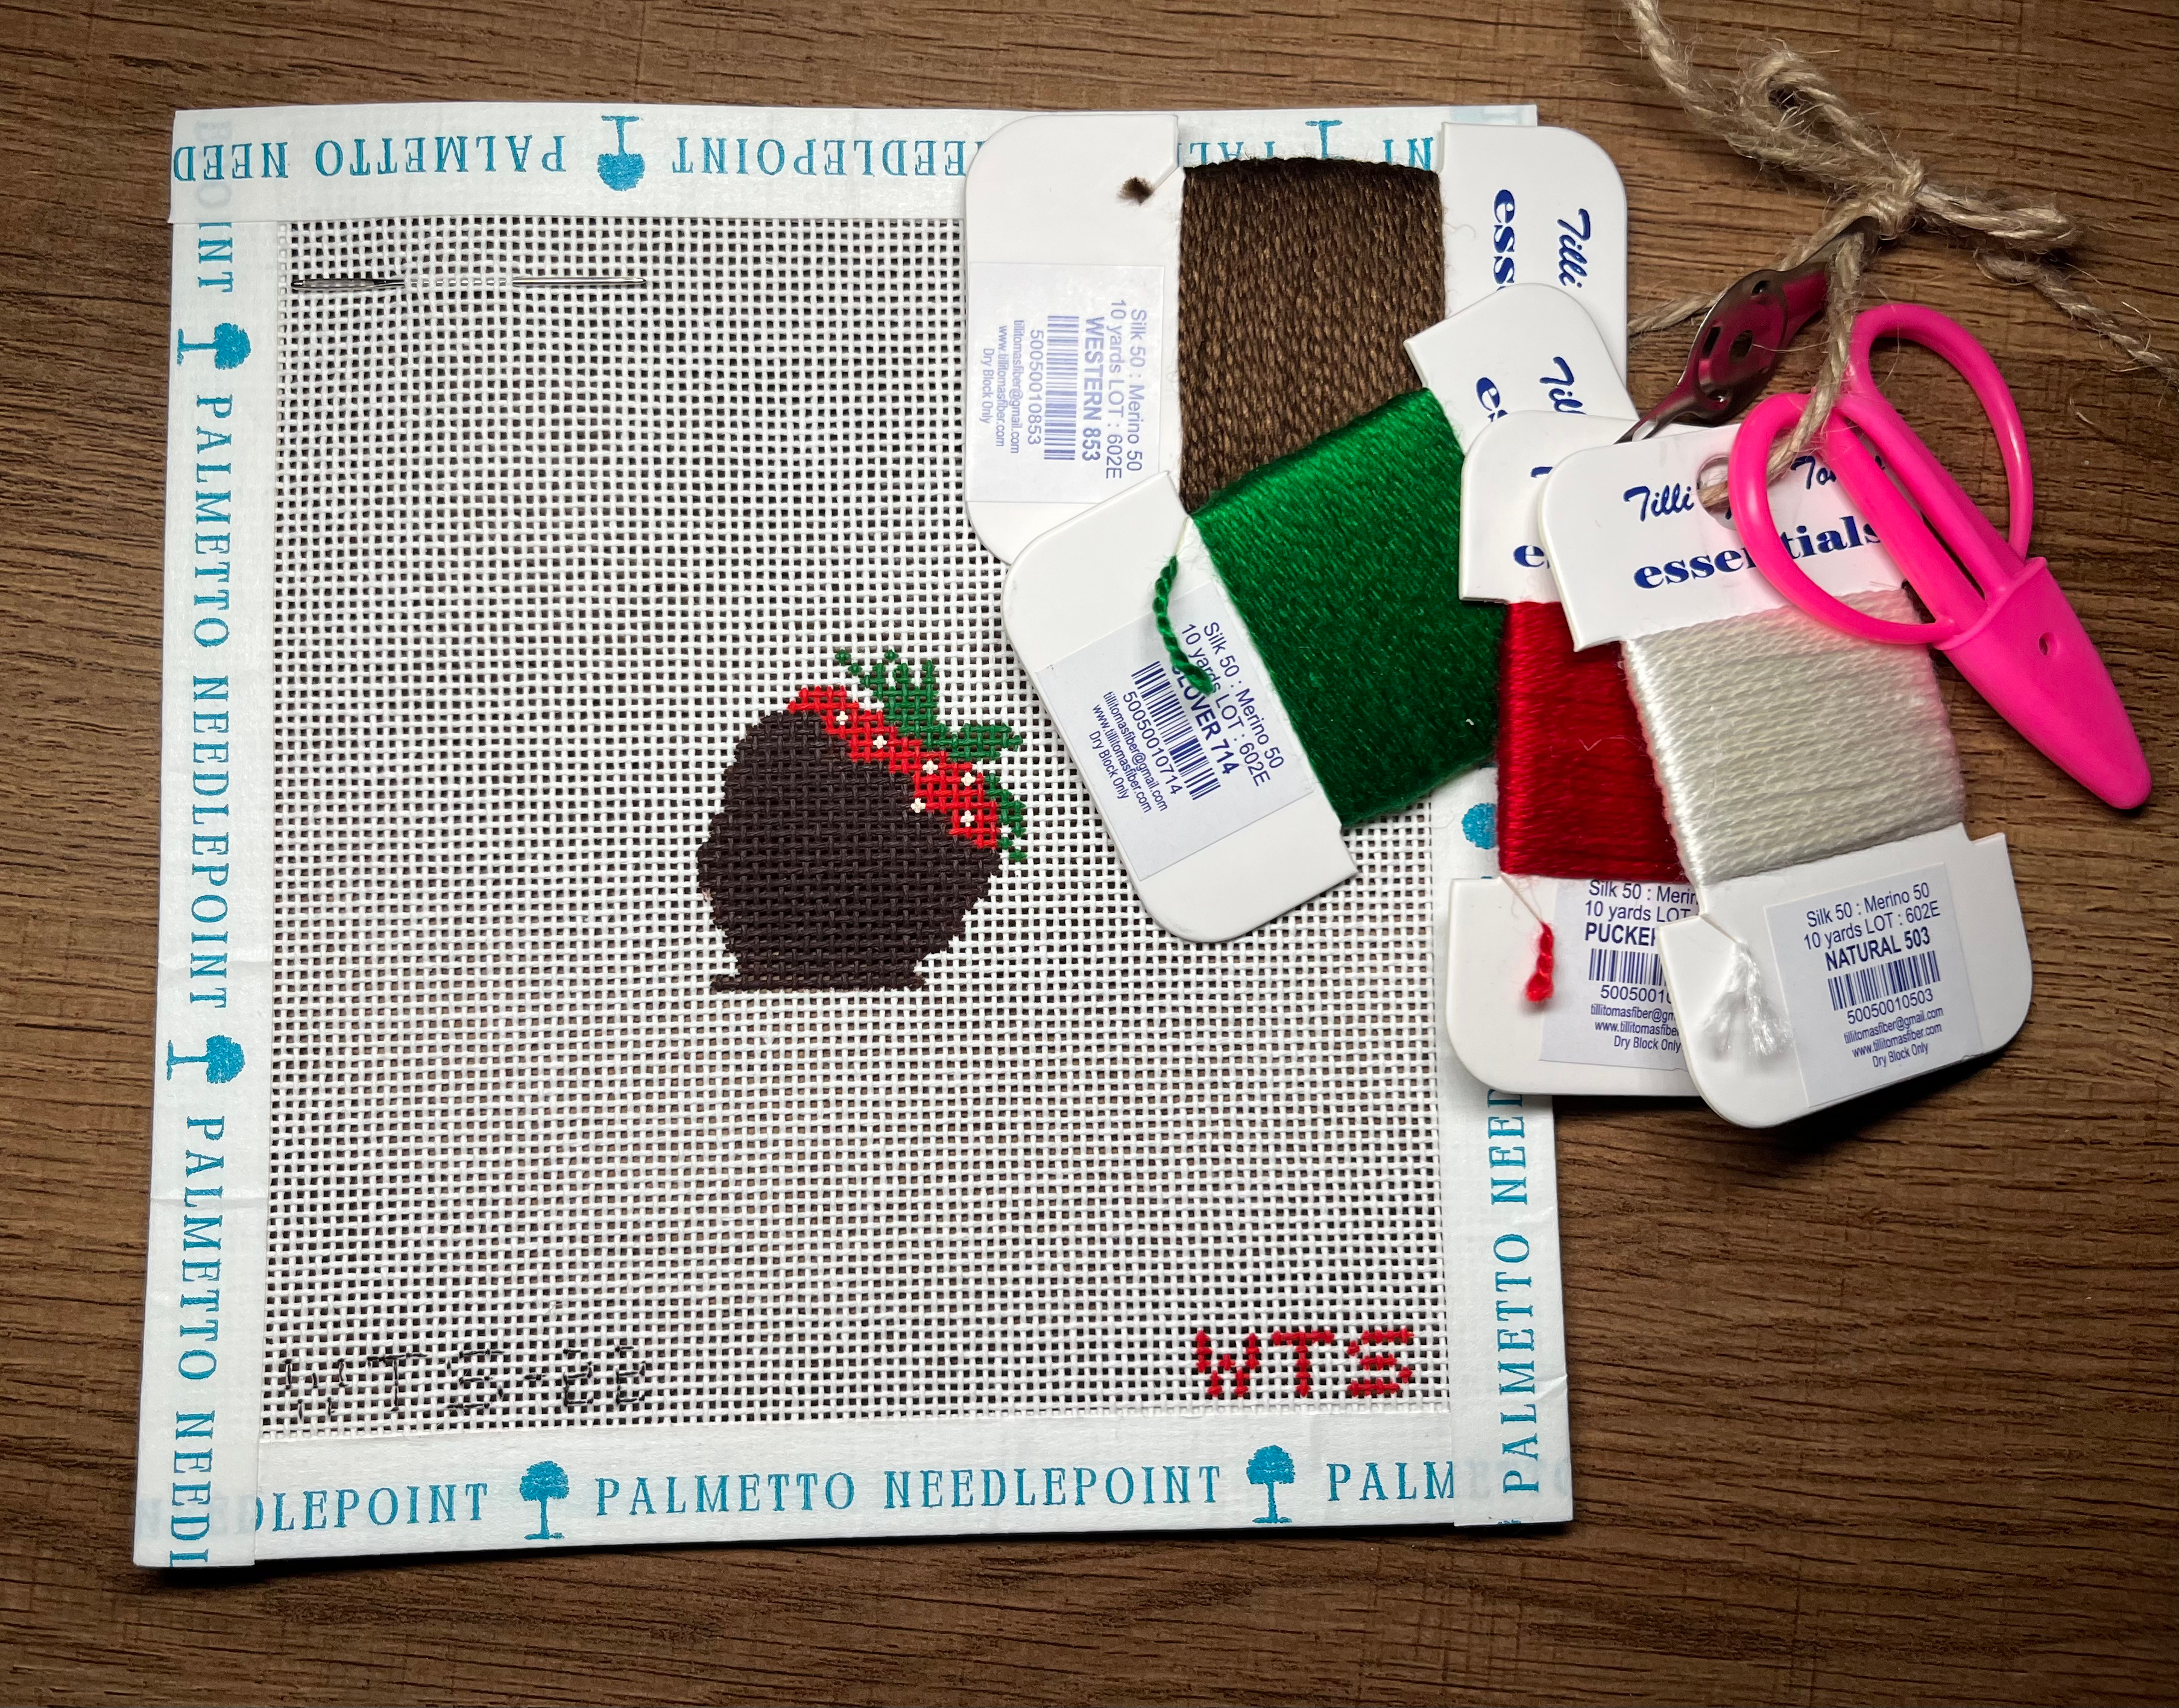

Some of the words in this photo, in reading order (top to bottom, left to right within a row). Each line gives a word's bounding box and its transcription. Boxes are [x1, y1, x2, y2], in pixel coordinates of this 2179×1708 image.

[173, 142, 289, 182] NEED
[314, 134, 567, 177] PALMETTO
[672, 136, 984, 177] EEDLEPOINT
[1493, 189, 1515, 292] ess
[1557, 208, 1591, 288] Tilli
[1111, 300, 1126, 320] 10
[1131, 309, 1146, 340] Silk
[980, 348, 995, 368] Dry
[1083, 317, 1105, 420] WESTERN
[1106, 326, 1125, 374] yards
[1130, 346, 1146, 367] 50
[982, 369, 995, 400] Block
[995, 326, 1008, 447] www.tillitomasfiber.com
[1009, 320, 1025, 453] tillitomasfiber@gmail.com
[1027, 330, 1044, 446] 50050010853
[1108, 380, 1124, 417] LOT
[1539, 356, 1587, 415] Til
[979, 401, 994, 424] Only
[1127, 385, 1145, 444] Merino
[1082, 427, 1102, 462] 853
[1106, 435, 1123, 479] 602E
[1126, 450, 1143, 471] 50
[193, 394, 233, 649] PALMETTO
[1623, 483, 1695, 522] Tilli
[1182, 623, 1201, 645] 10
[1216, 694, 1244, 729] LOT
[1240, 743, 1271, 787] 602E
[1204, 622, 1226, 655] Silk
[1220, 655, 1240, 677] 50
[1235, 688, 1269, 745] Merino
[1264, 746, 1284, 769] 50
[1092, 704, 1152, 813] www.tillitomasfiber.com
[1103, 691, 1168, 811] tillitomasfiber@gmail.com
[1123, 691, 1183, 795] 50050010714
[1211, 739, 1240, 775] 714
[1090, 731, 1103, 750] Dry
[1099, 750, 1118, 779] Block
[1112, 778, 1129, 800] Only
[189, 675, 230, 1009] NEEDLEPOINT
[1585, 901, 1604, 917] 10
[1608, 905, 1651, 922] yards
[1589, 880, 1617, 899] Silk
[1622, 883, 1641, 900] 50
[1656, 886, 1698, 905] Merin
[1806, 907, 1833, 928] Silk
[1835, 902, 1852, 921] 50
[1864, 890, 1909, 914] Merino
[1913, 882, 1929, 900] 50
[1804, 931, 1821, 950] 10
[1824, 923, 1862, 950] yards
[1865, 912, 1893, 934] LOT
[1905, 900, 1940, 924] 602E
[1825, 934, 1902, 971] NATURAL
[1905, 926, 1930, 950] 503
[1591, 1003, 1676, 1023] tillitomasfiber@gm
[1844, 1007, 1944, 1044] tillitomasfiber@gmail.com
[1847, 988, 1933, 1024] 50050010503
[1595, 1021, 1679, 1036] www.tillitomasfibe
[1613, 1035, 1631, 1050] Dry
[1633, 1036, 1659, 1050] Block
[1661, 1038, 1681, 1053] Only
[1852, 1023, 1942, 1057] www.tillitomasfiber.com
[1872, 1052, 1887, 1068] Dry
[1889, 1047, 1910, 1064] Block
[1912, 1041, 1928, 1057] Only
[177, 1115, 226, 1380] PALMETTO
[1196, 1329, 1414, 1398] WTS
[1493, 1234, 1539, 1493] PALMETTO
[595, 1472, 856, 1517] PALMETTO
[884, 1465, 1220, 1509] NEEDLEPOINT
[1326, 1461, 1454, 1503] PALM
